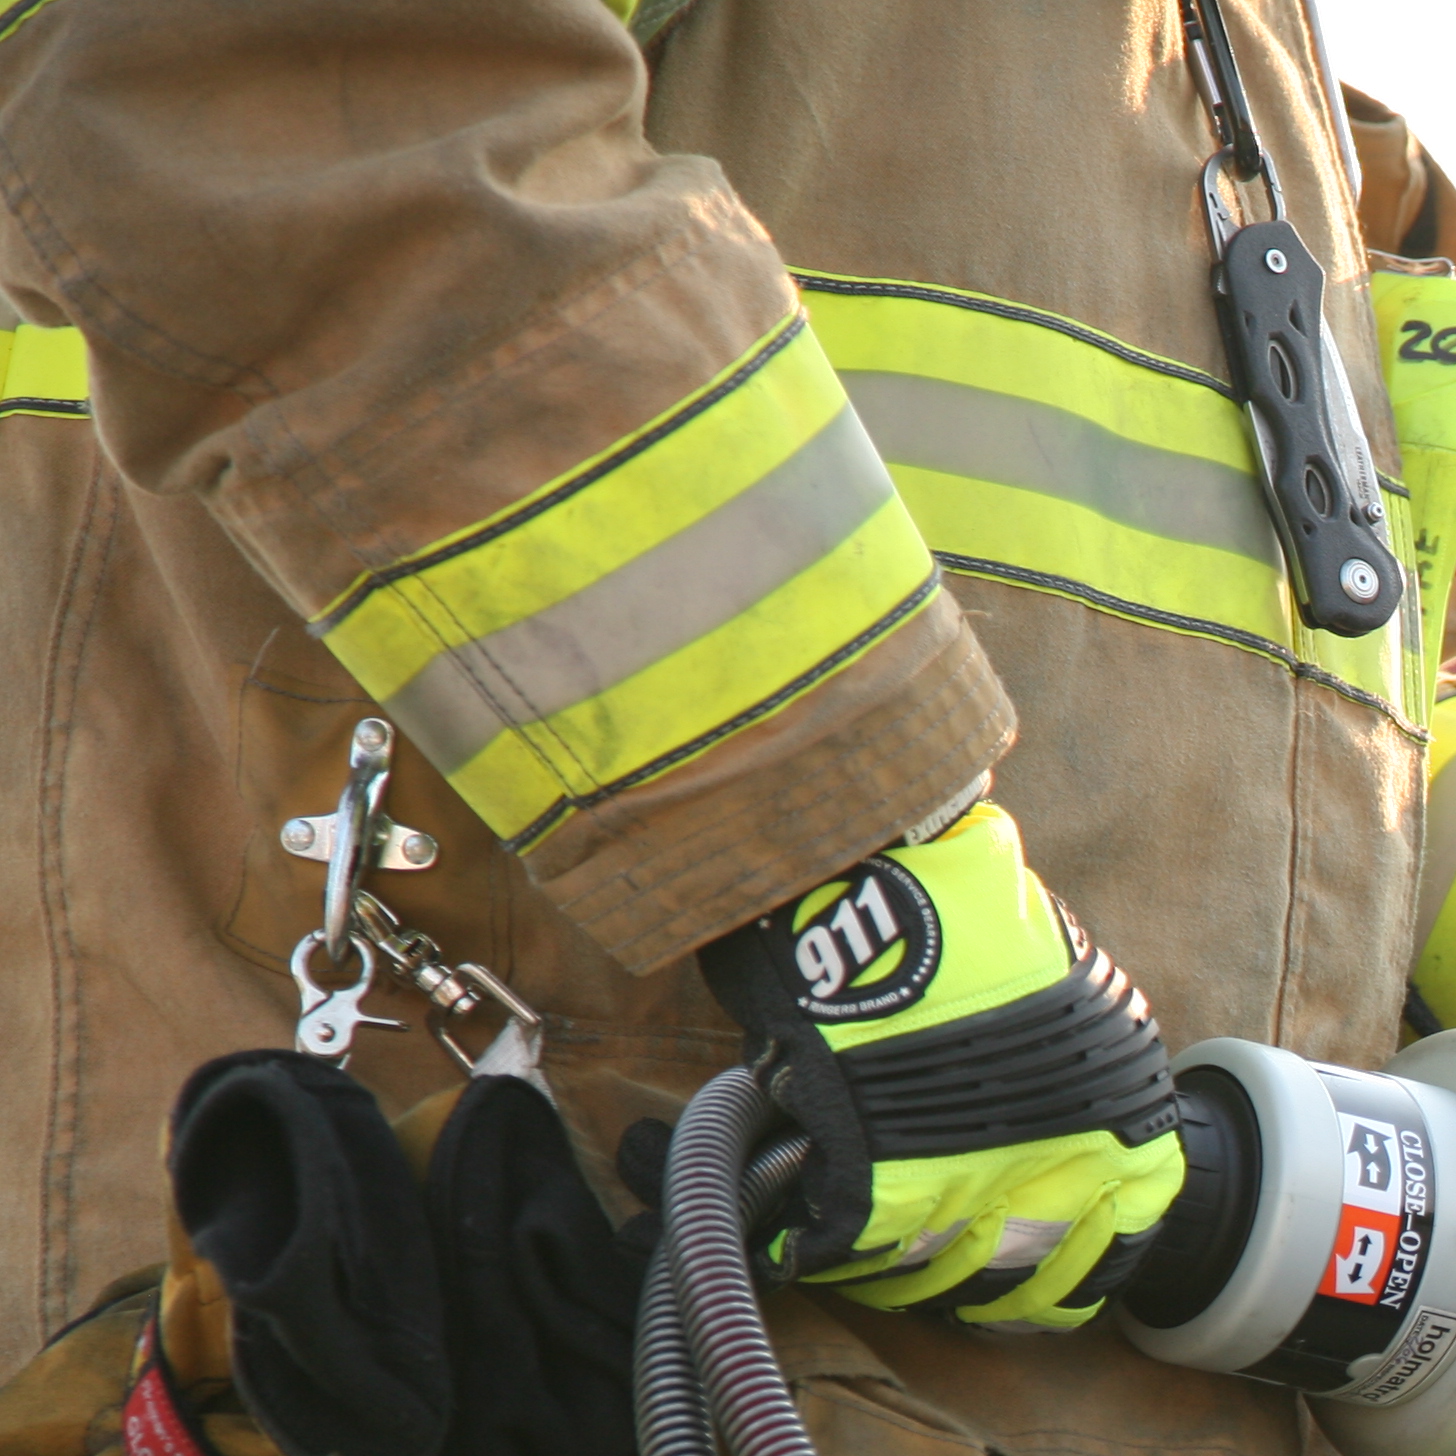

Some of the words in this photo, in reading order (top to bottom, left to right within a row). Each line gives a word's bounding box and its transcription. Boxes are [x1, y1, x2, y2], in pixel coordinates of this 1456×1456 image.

[890, 867, 929, 906] SERVICE
[795, 875, 900, 999] 911
[859, 993, 900, 1011] BRAND
[1363, 1325, 1451, 1402] holmatro
